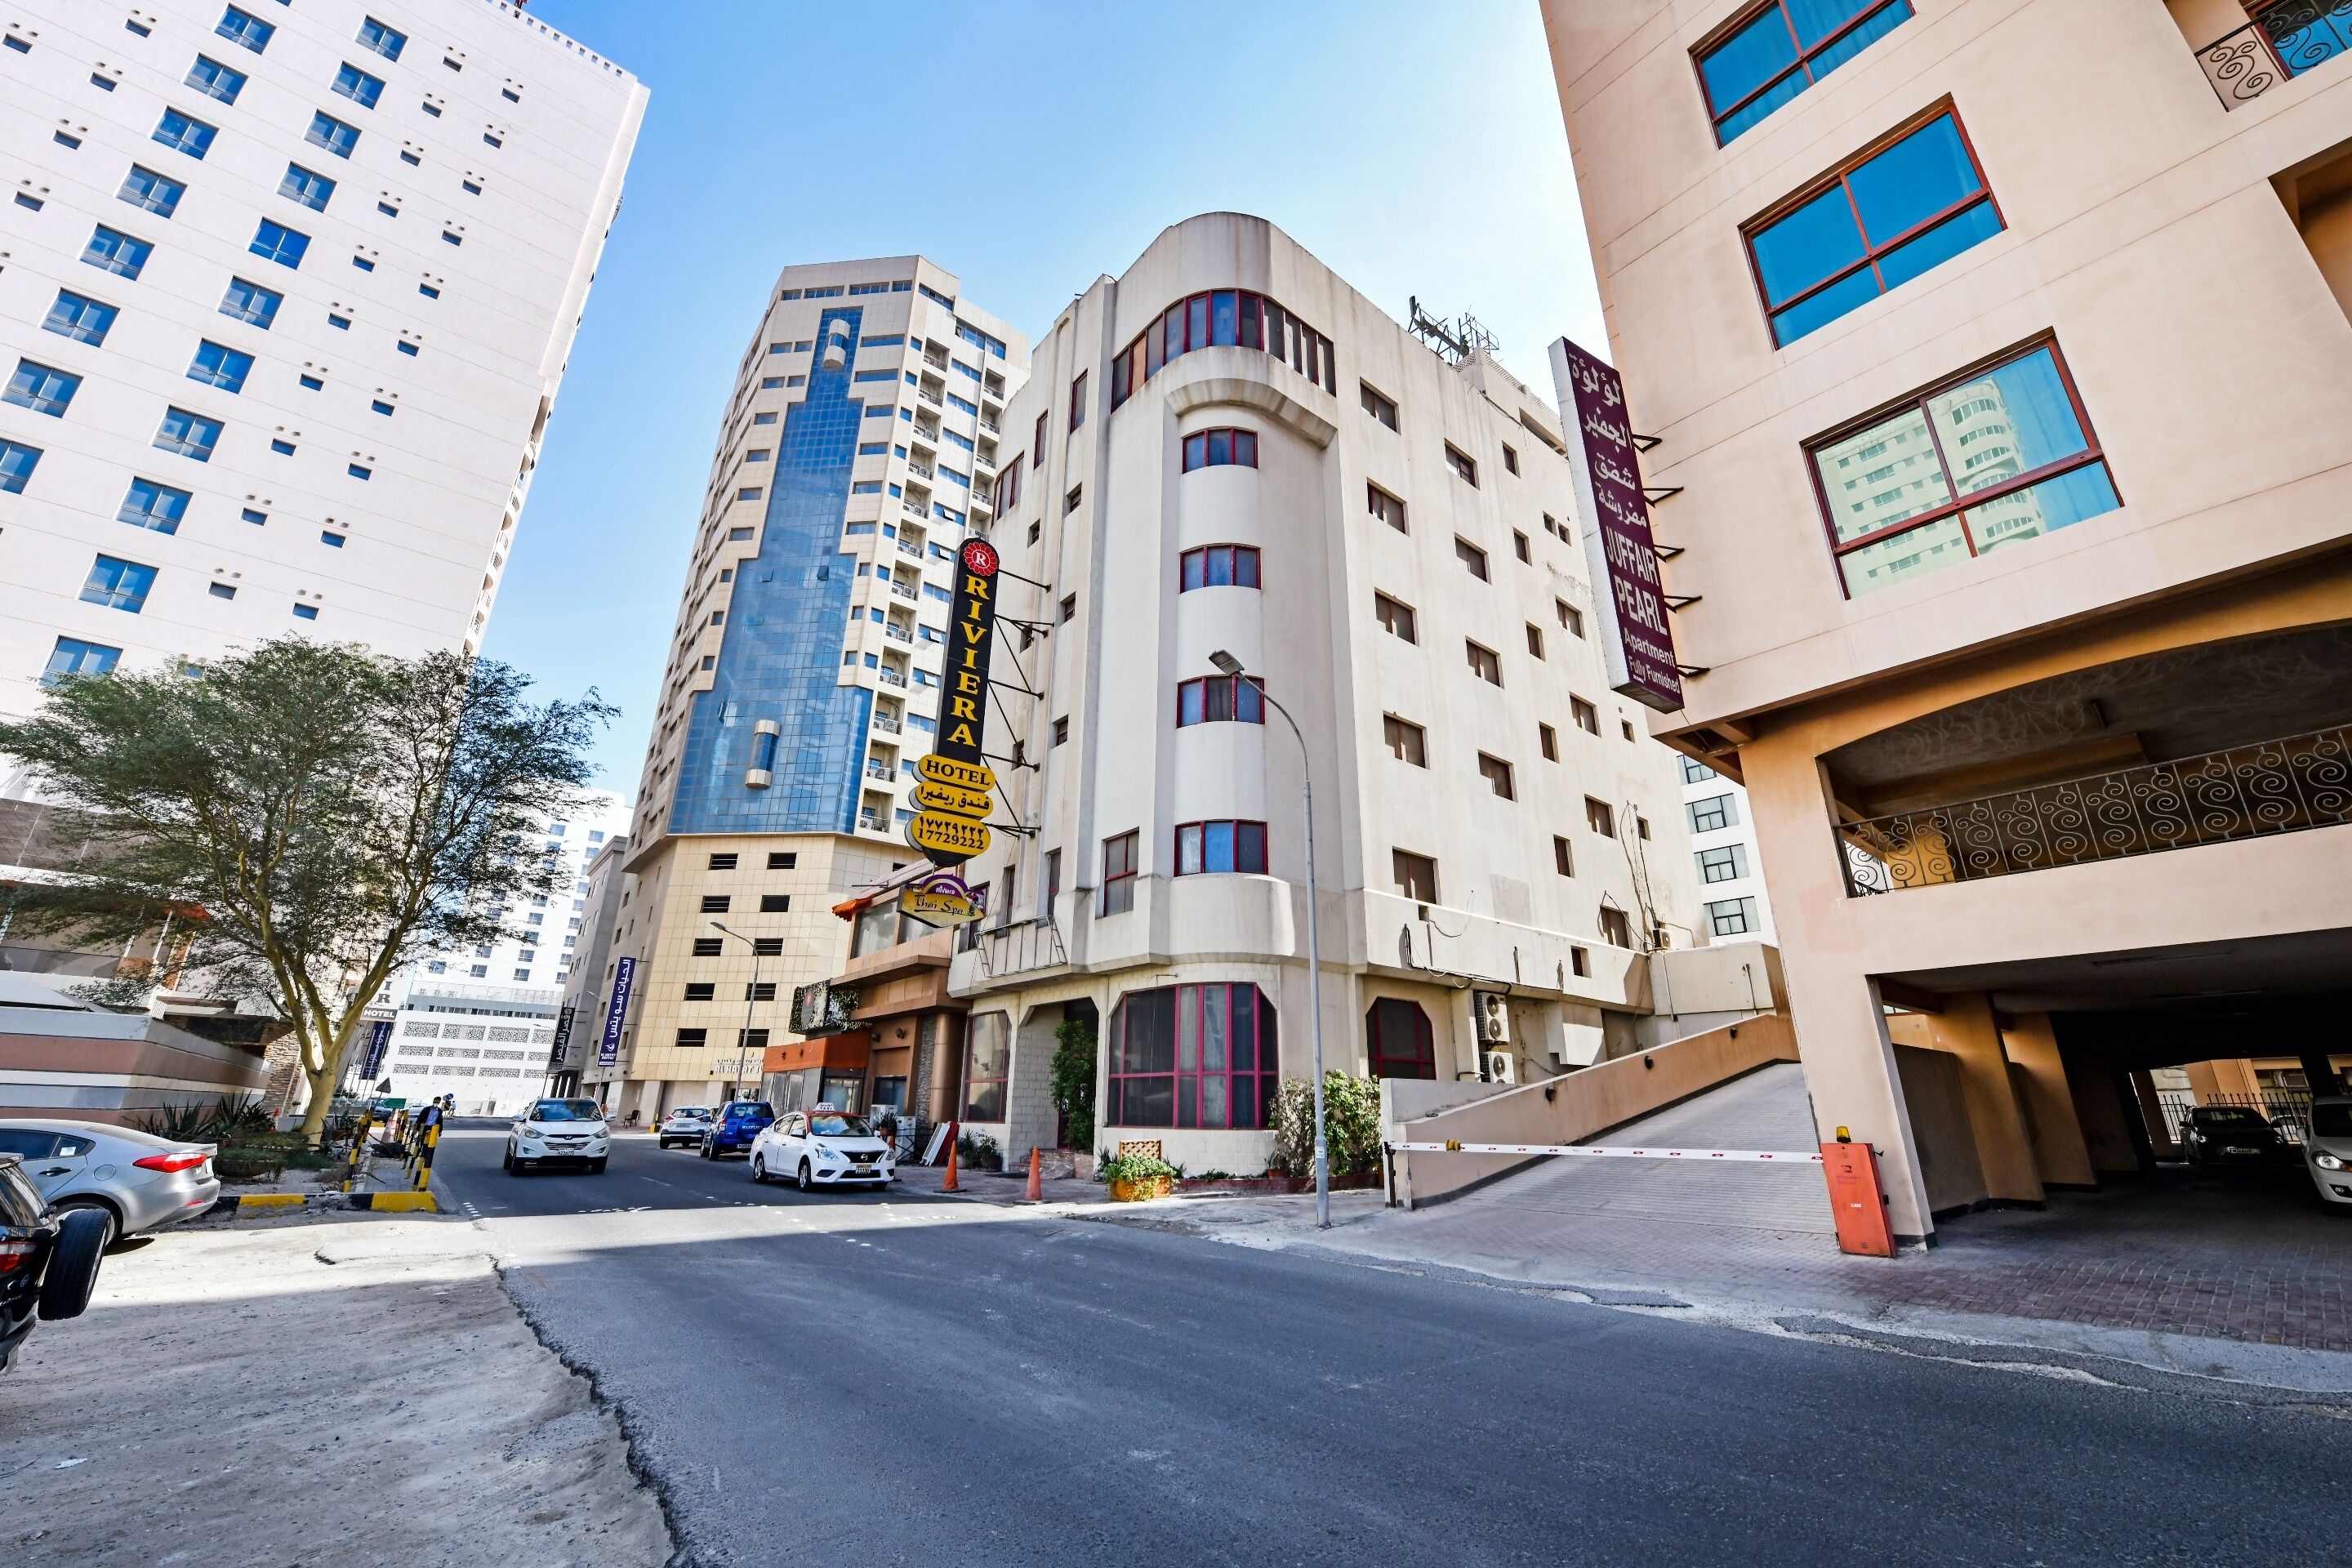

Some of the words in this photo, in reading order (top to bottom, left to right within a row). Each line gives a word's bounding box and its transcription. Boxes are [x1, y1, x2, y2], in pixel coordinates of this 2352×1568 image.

[1568, 352, 1621, 407] لؤلؤة
[1584, 407, 1633, 453] الجفير
[1594, 452, 1636, 491] شقق
[1595, 481, 1647, 528] مفروشة
[975, 551, 987, 567] R
[1606, 525, 1659, 586] JUFFAIR
[1614, 574, 1668, 636] PEARL
[947, 574, 990, 747] RIVIERA
[1624, 626, 1676, 668] Apartment
[1628, 655, 1646, 684] Fully
[1646, 663, 1681, 694] Furnished
[924, 759, 991, 786] HOTEL
[920, 785, 955, 806] ريفيرا
[957, 792, 990, 810] فندق
[917, 827, 984, 850] 17729222
[914, 894, 938, 909] Thai
[940, 901, 964, 916] Spa
[363, 1009, 395, 1018] HOTEL
